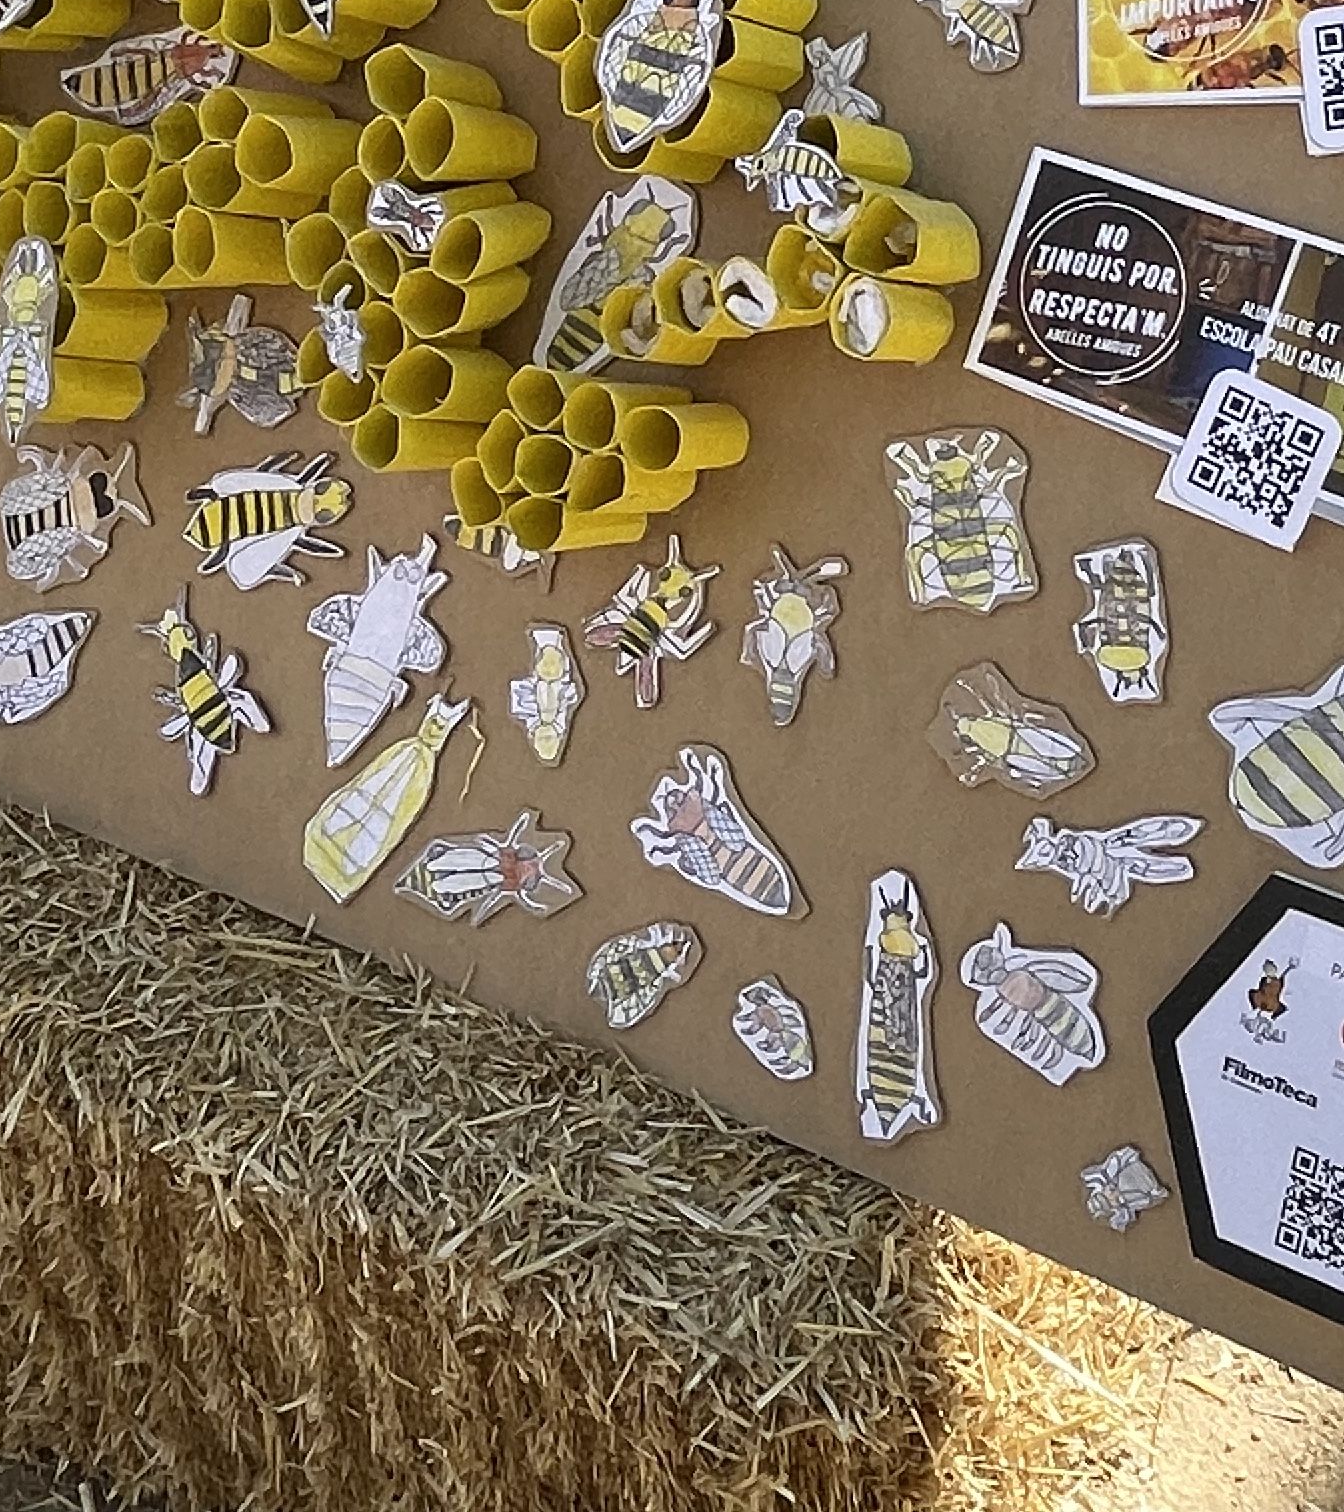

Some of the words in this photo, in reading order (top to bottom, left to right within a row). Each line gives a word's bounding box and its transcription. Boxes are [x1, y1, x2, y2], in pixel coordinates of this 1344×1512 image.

[1094, 222, 1130, 251] NO
[1036, 244, 1126, 283] TINGUIS
[1128, 260, 1178, 295] POR.
[1028, 289, 1167, 339] RESPECTA'M.
[1316, 322, 1342, 346] 4T
[1199, 316, 1265, 355] ESCOLA
[1266, 338, 1298, 366] PAU
[1222, 1056, 1318, 1108] FilmoTeca
